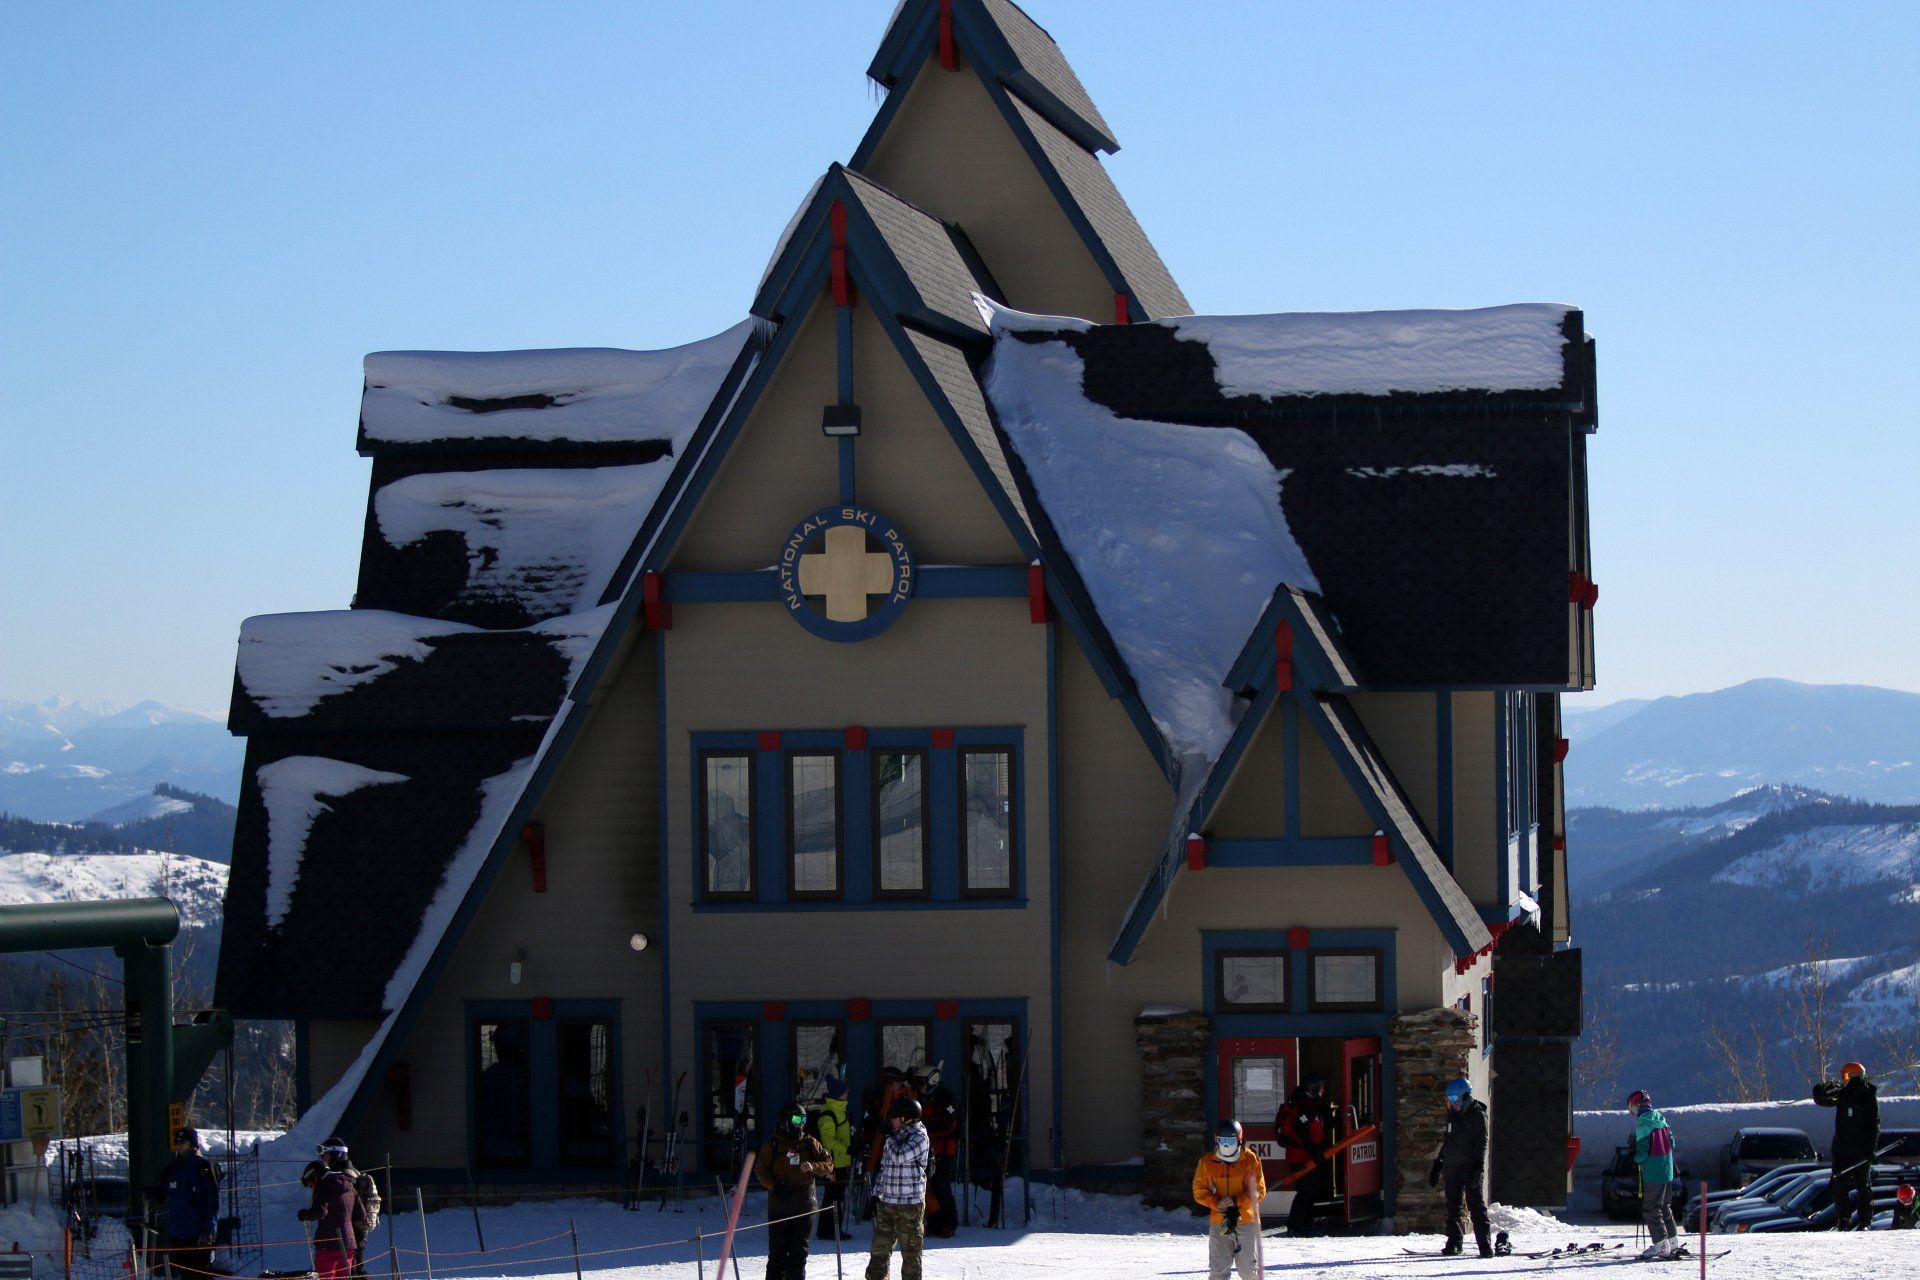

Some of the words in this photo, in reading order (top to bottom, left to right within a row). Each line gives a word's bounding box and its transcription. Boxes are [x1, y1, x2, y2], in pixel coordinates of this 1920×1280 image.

[781, 516, 827, 610] NATIONAL
[841, 508, 876, 526] SKI
[884, 529, 910, 604] PATROL
[1249, 1143, 1271, 1158] SKI
[1352, 1143, 1376, 1161] PATROL
